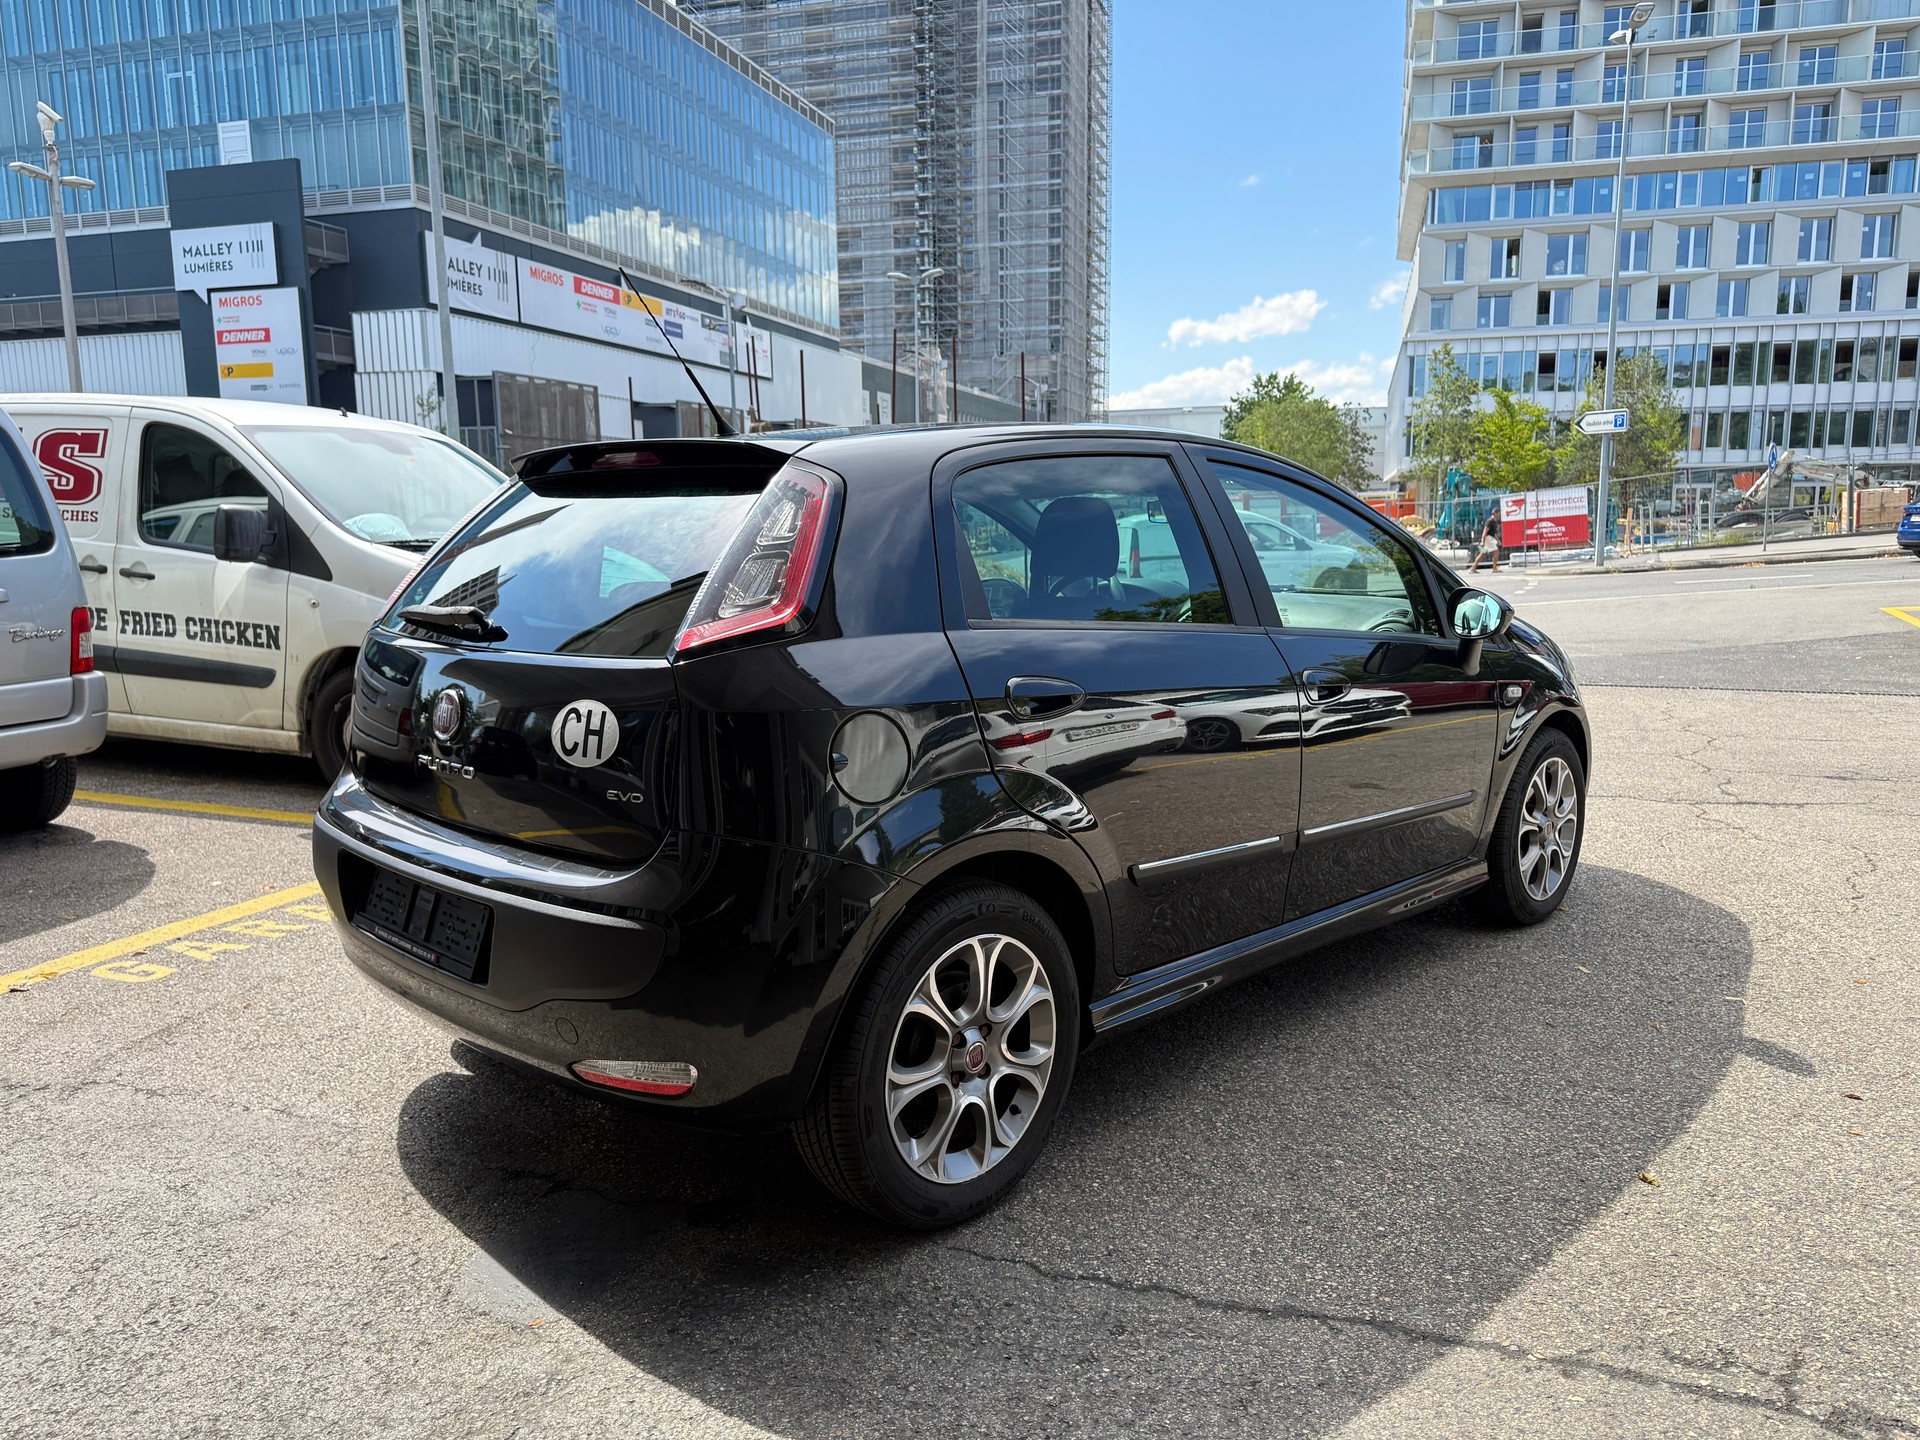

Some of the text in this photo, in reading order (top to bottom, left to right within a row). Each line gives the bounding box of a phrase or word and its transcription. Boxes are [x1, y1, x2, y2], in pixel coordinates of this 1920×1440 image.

[183, 241, 233, 258] MALLEY
[184, 259, 234, 274] LUMIÈRES
[447, 256, 483, 278] ALLEY
[530, 266, 564, 287] MIGROS
[447, 276, 483, 296] MIÈRES
[581, 281, 614, 300] DENNER
[218, 295, 263, 308] MIGROS
[222, 329, 266, 343] DENNER
[9, 626, 66, 643] Berlingo
[119, 609, 177, 638] FRIED
[184, 615, 281, 650] CHICKEN
[559, 706, 607, 760] CH
[606, 789, 644, 803] EVO
